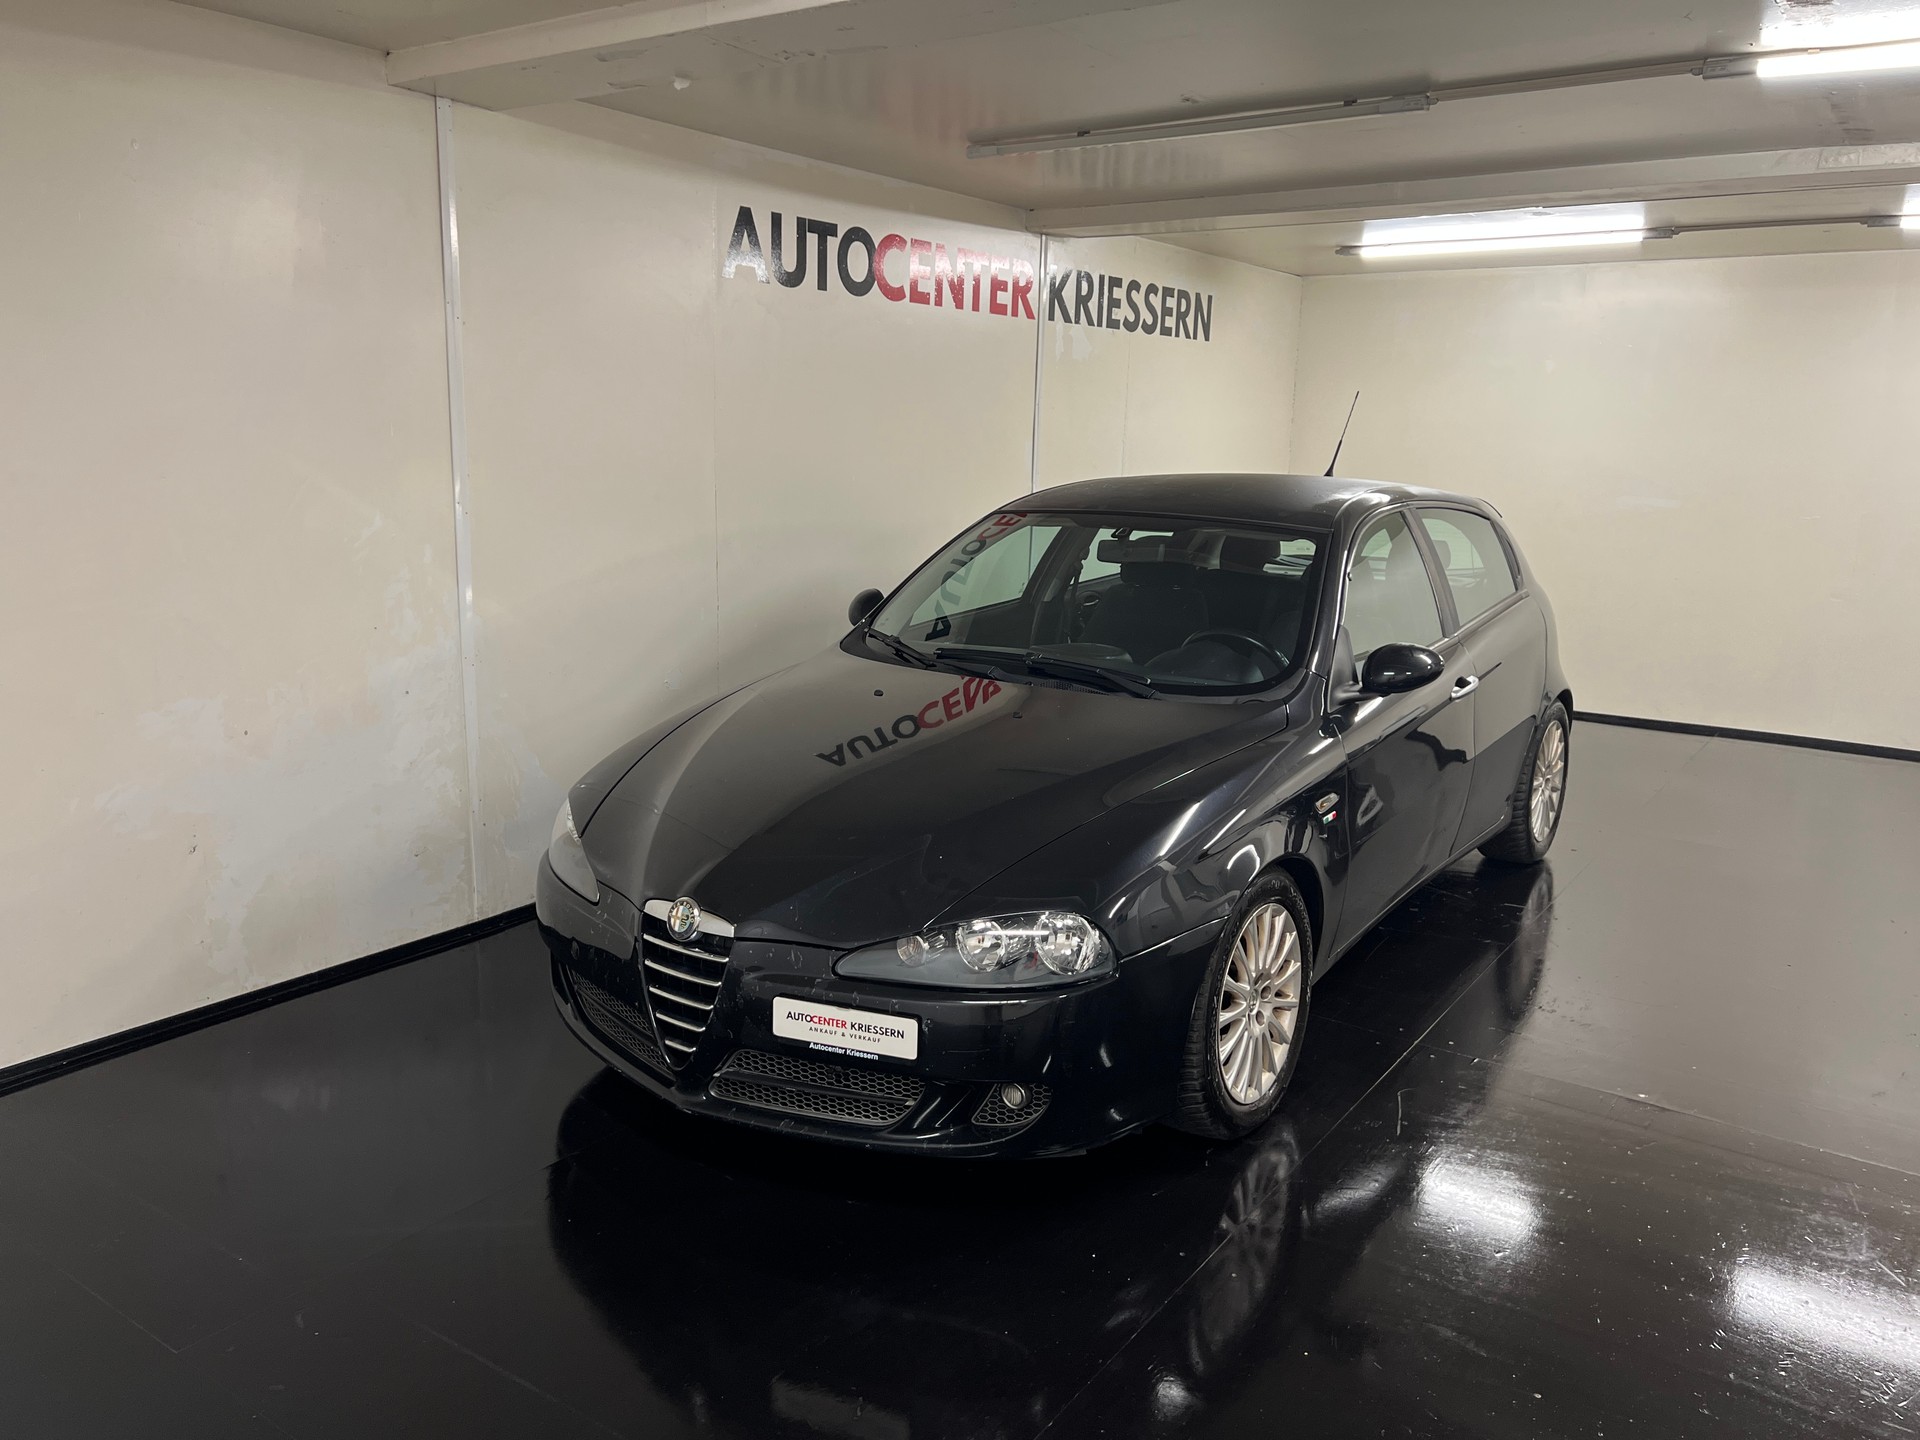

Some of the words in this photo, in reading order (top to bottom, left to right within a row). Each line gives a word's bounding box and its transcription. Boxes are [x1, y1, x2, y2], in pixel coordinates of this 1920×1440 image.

[721, 206, 1036, 321] AUTOCENTER
[1049, 264, 1213, 342] KRIESSERN
[786, 1011, 847, 1030] AUTOCENTER
[850, 1021, 905, 1040] KRIESSERN
[808, 1026, 838, 1037] ANKAUF
[849, 1034, 882, 1044] VERKAUF
[809, 1042, 846, 1055] Autocenter
[846, 1048, 879, 1061] Kriessern
